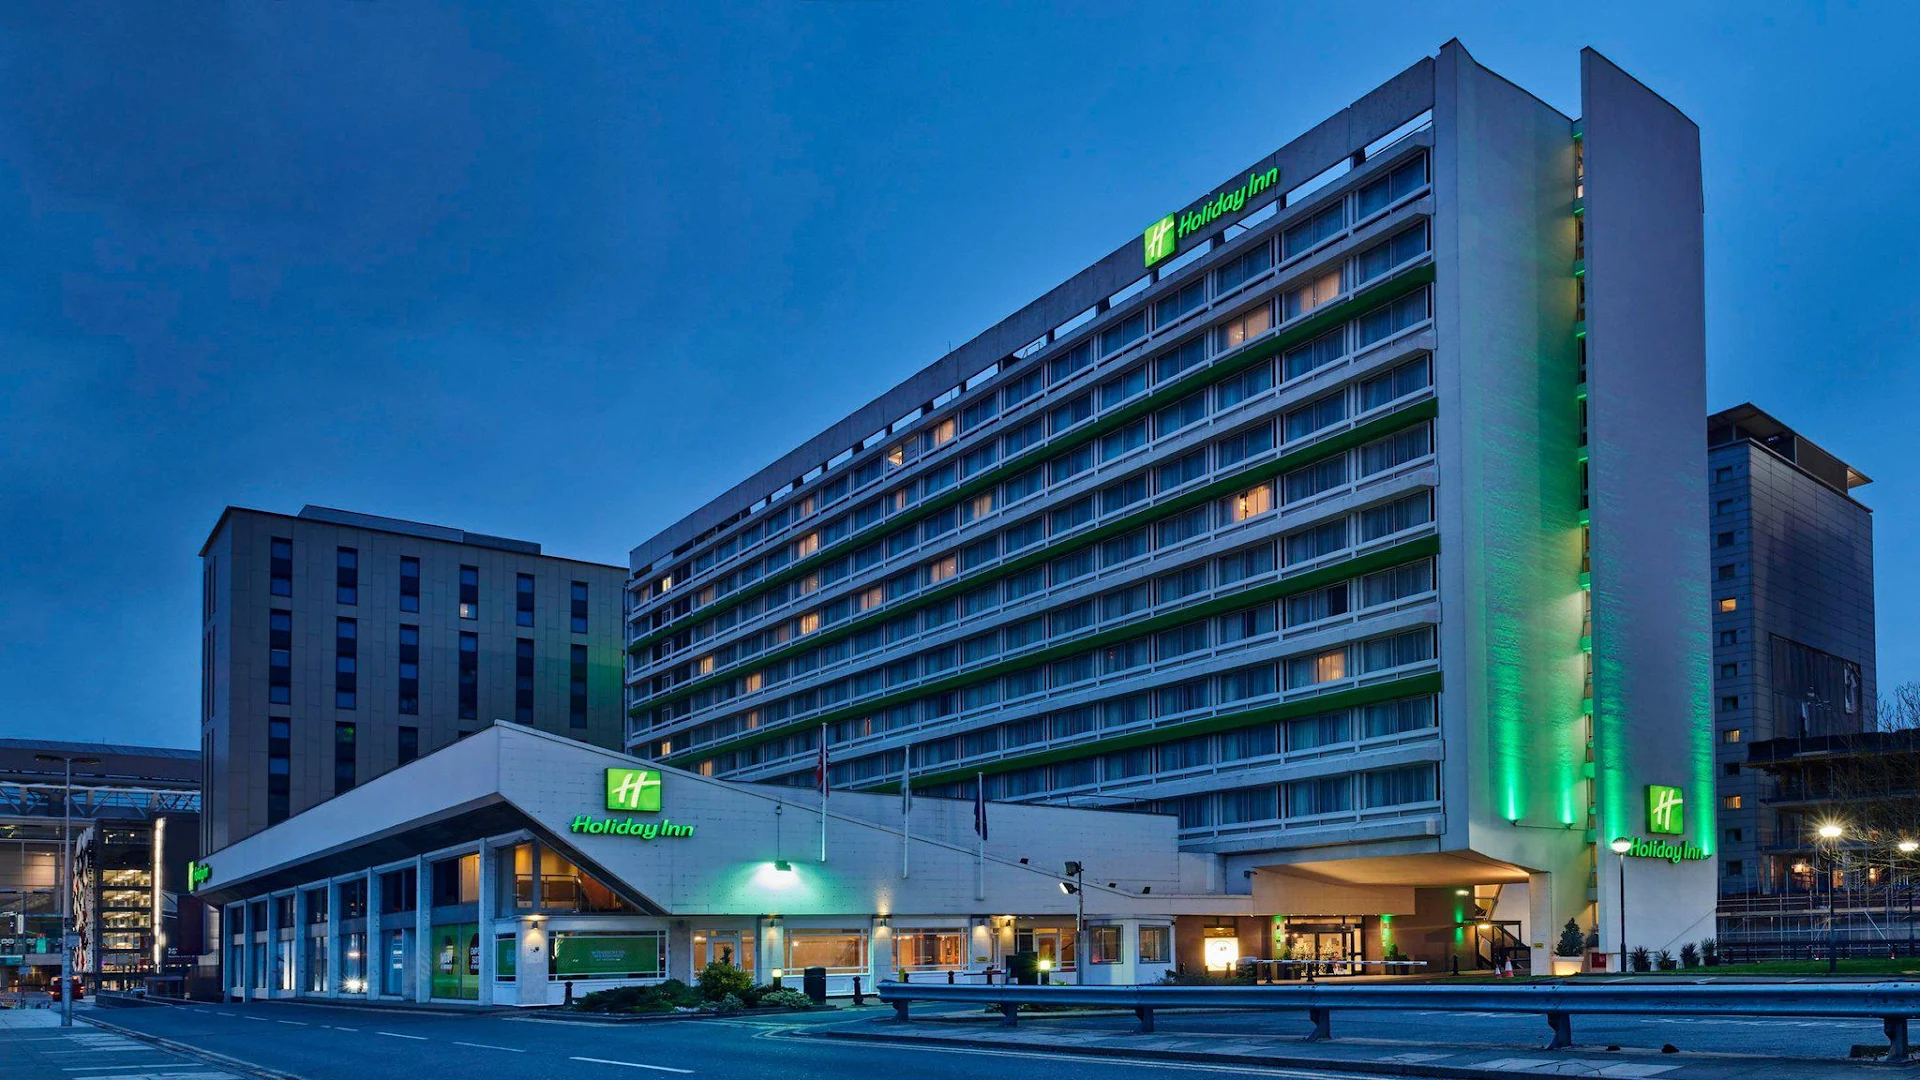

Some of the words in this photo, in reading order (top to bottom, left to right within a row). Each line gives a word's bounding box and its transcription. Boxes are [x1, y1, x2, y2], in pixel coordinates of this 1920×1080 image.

[1178, 185, 1246, 239] Holiday
[1248, 167, 1278, 198] Inn
[571, 815, 658, 840] Holiday
[660, 819, 694, 837] Inn
[1629, 837, 1682, 863] Holiday
[1683, 840, 1705, 860] Inn
